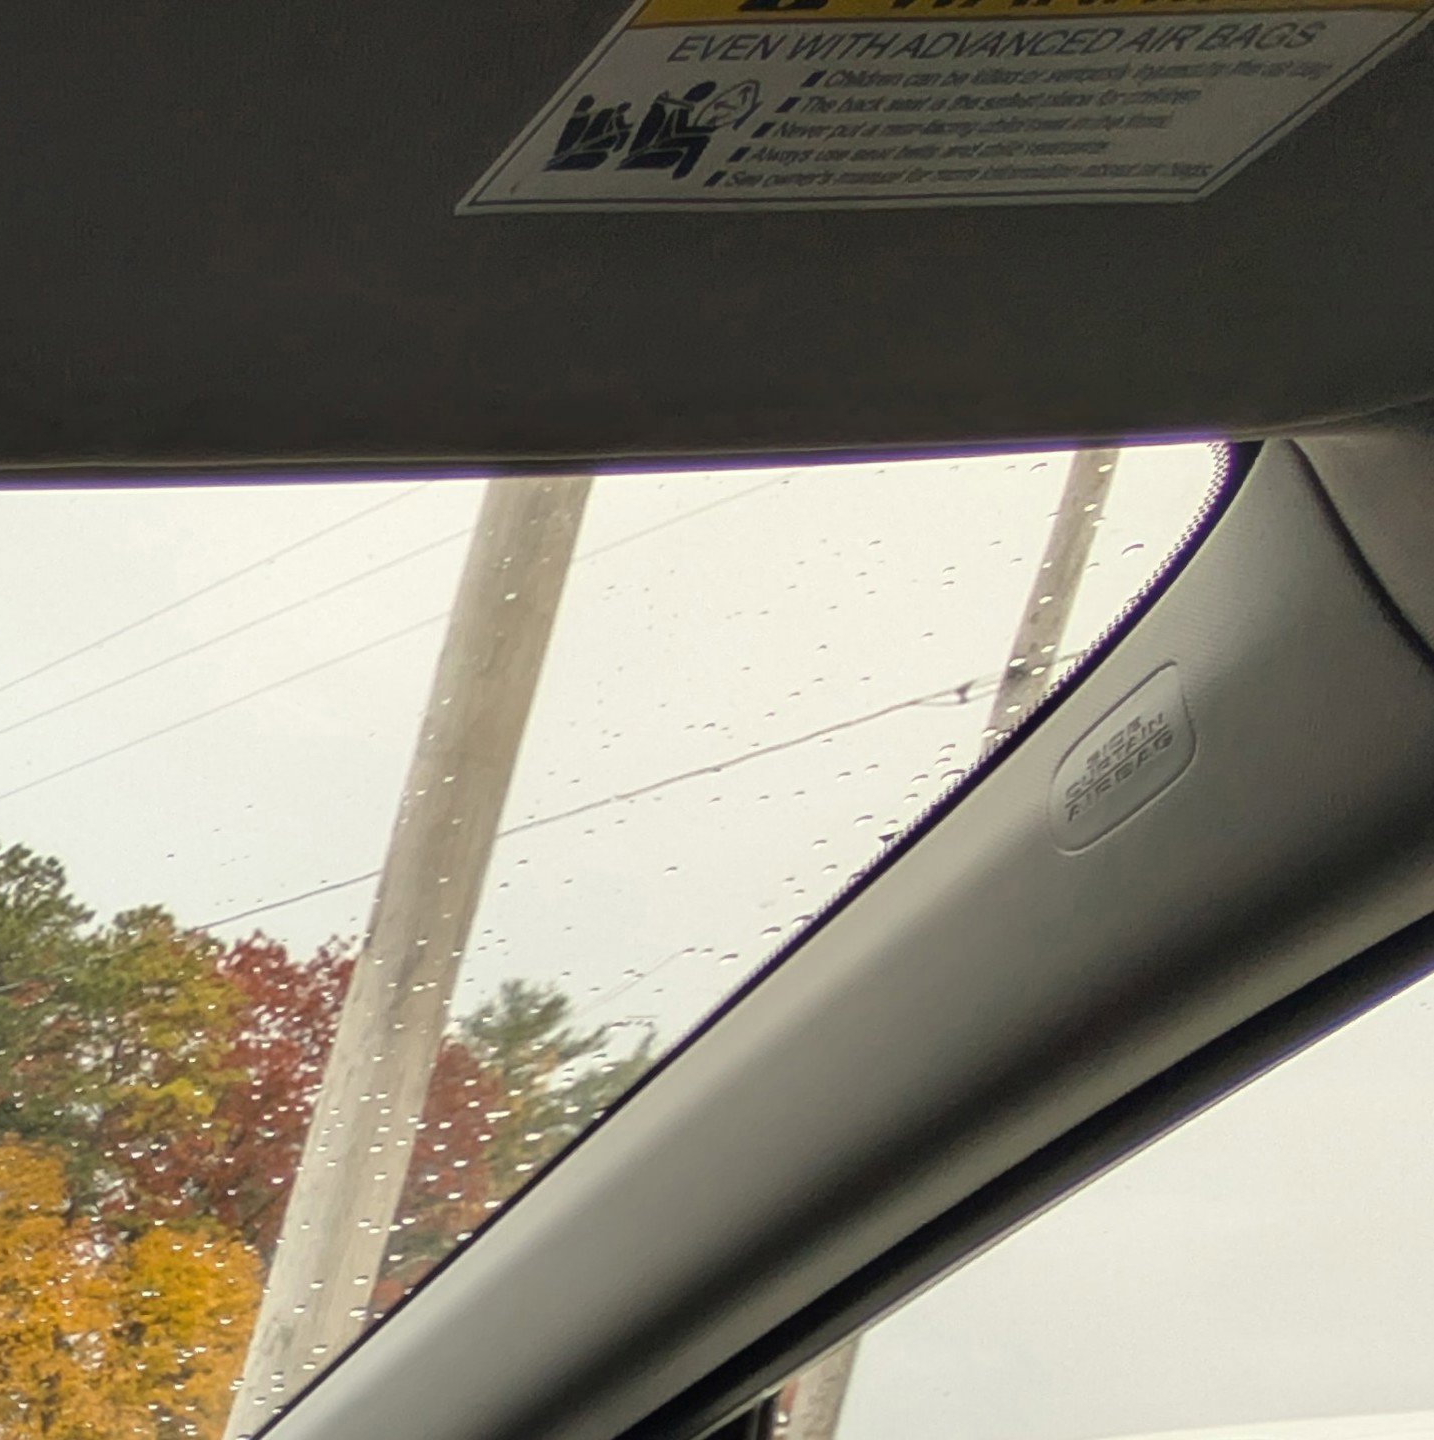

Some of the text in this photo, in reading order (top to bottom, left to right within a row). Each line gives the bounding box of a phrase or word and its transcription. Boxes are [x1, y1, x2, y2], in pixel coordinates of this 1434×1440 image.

[668, 21, 1327, 62] EVEN WITH ADVANCED AIR BAGS
